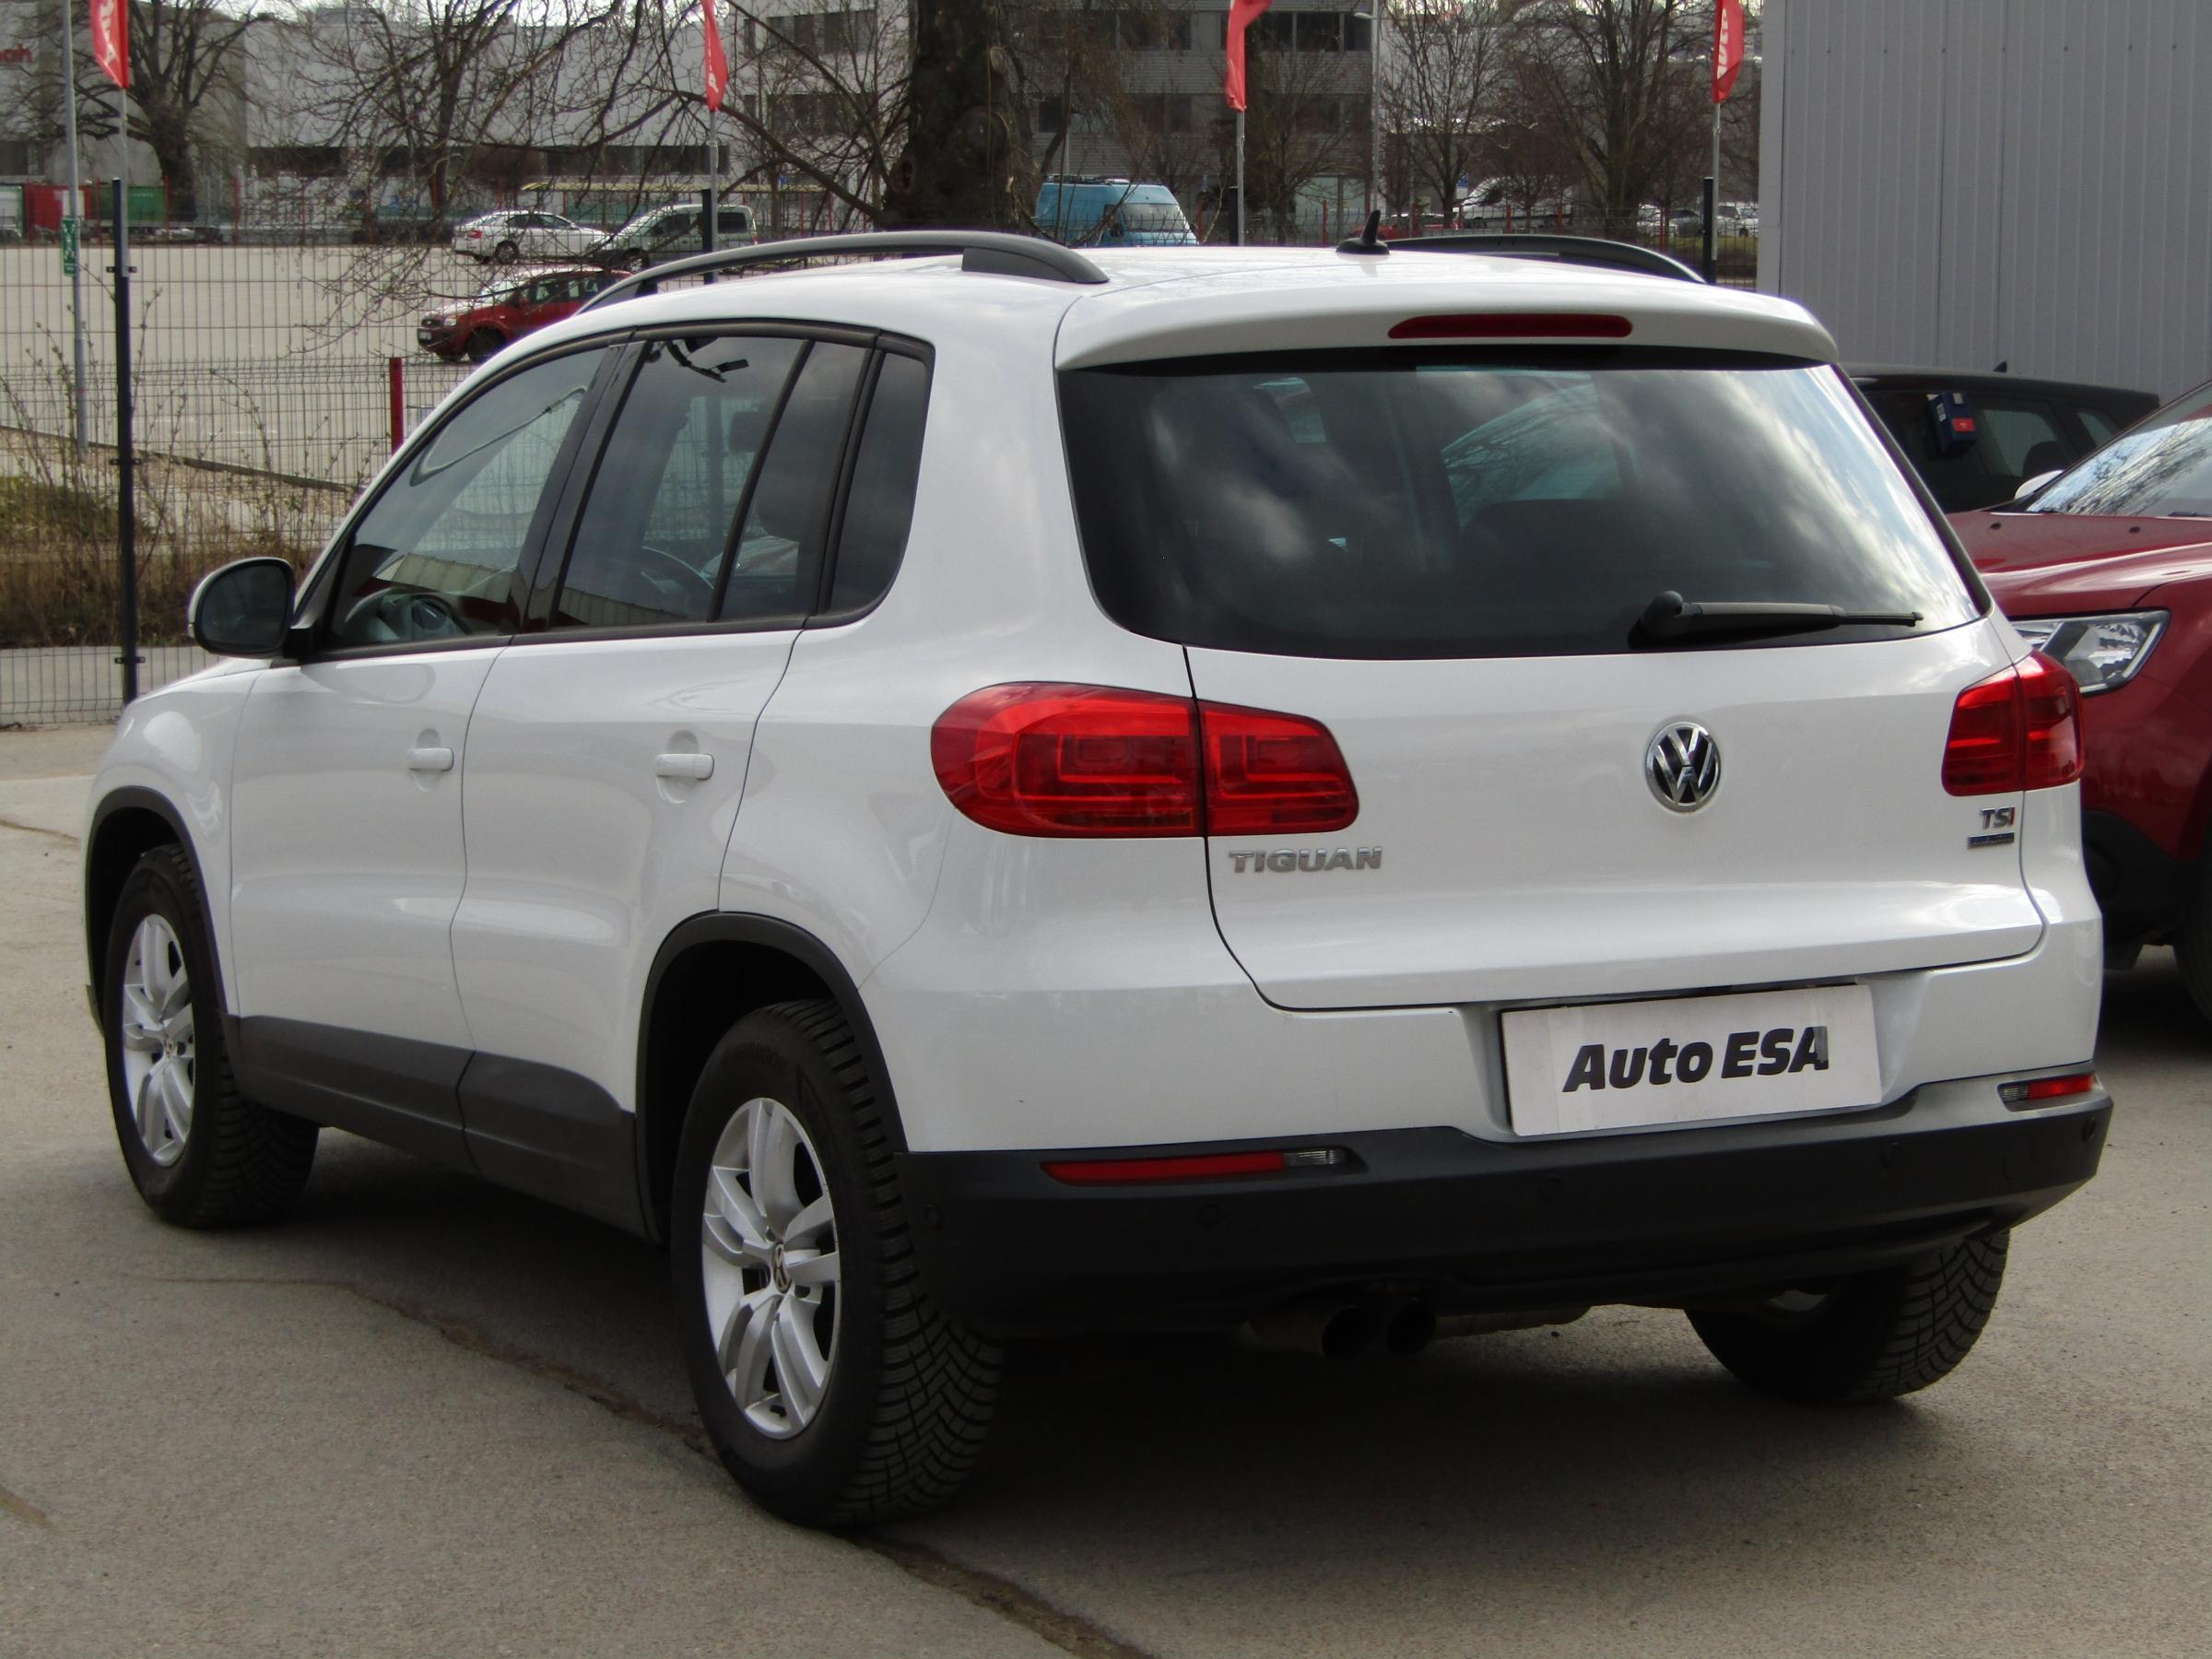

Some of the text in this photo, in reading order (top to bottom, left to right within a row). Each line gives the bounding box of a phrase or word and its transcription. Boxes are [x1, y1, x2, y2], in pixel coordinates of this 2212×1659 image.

[1979, 806, 2016, 830] TSI
[1229, 846, 1382, 874] TIGUAN
[1562, 1026, 1830, 1093] Auto ESA
